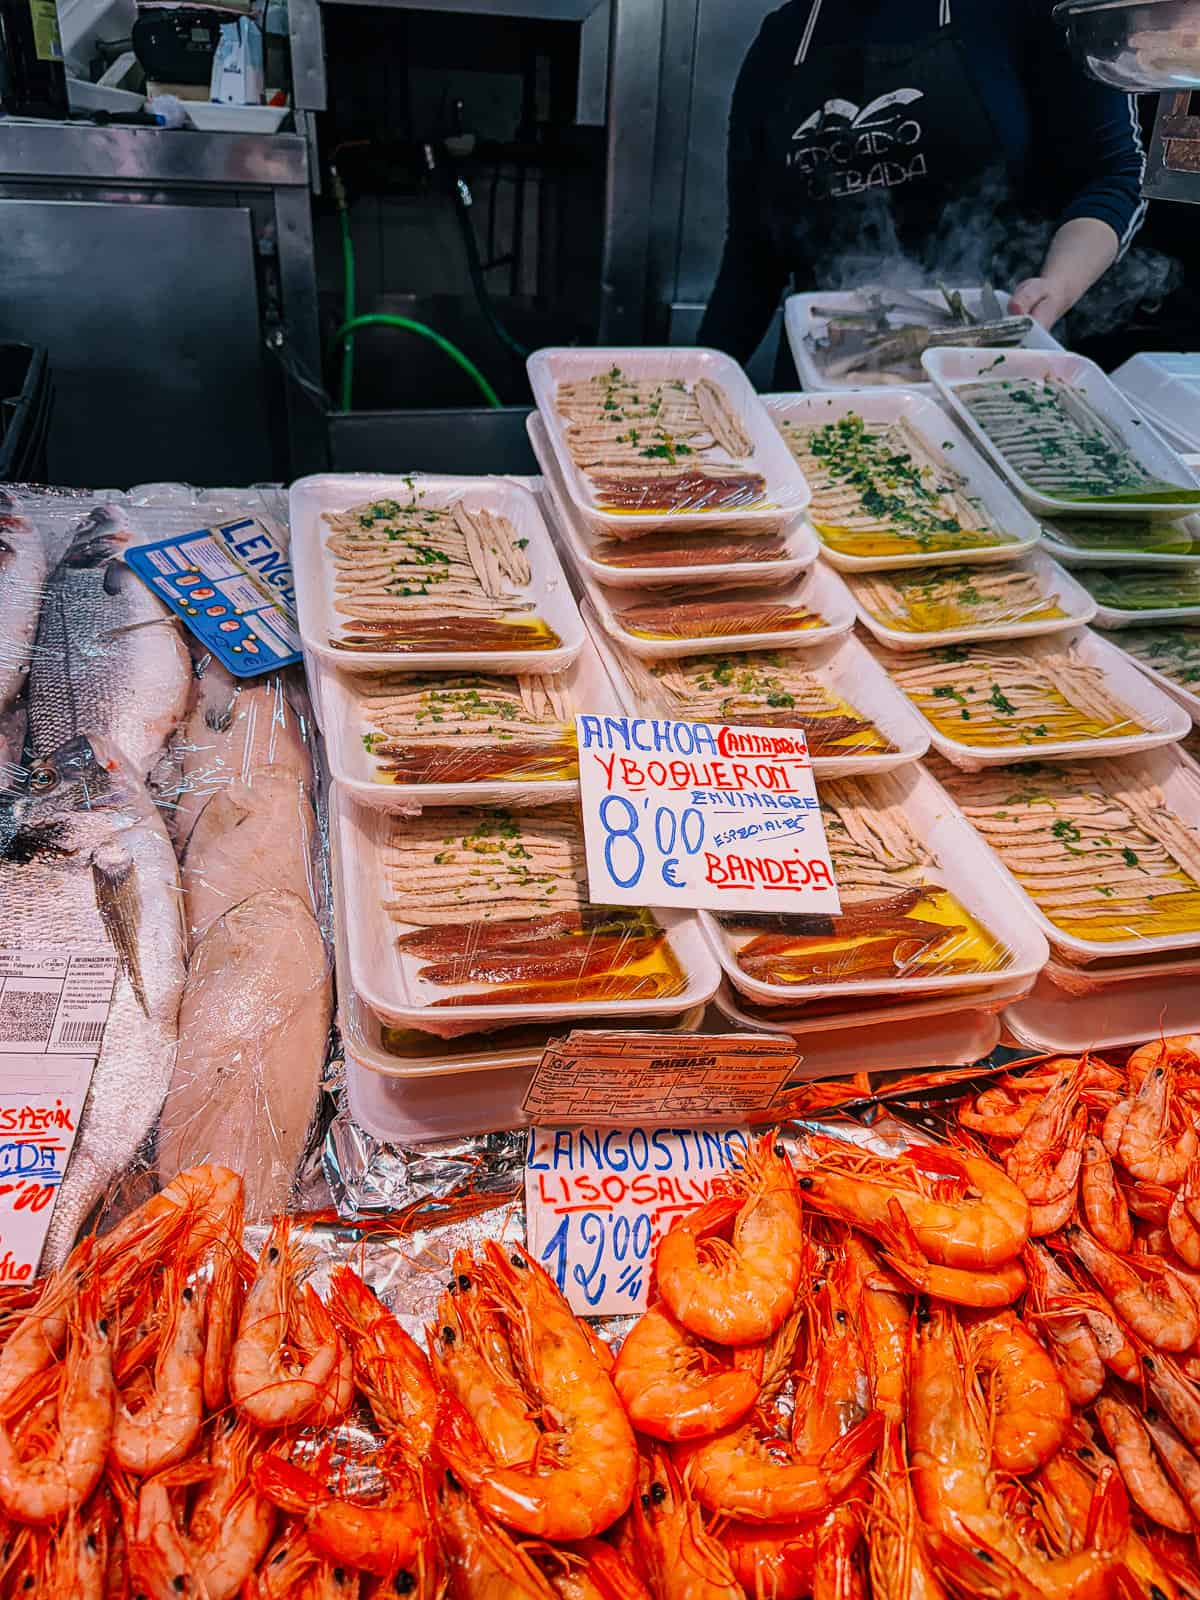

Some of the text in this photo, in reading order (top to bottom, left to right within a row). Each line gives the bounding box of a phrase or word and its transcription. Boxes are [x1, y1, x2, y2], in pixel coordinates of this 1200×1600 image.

[661, 849, 834, 888] € BANDEJA
[527, 1127, 748, 1171] LANGOSTINO
